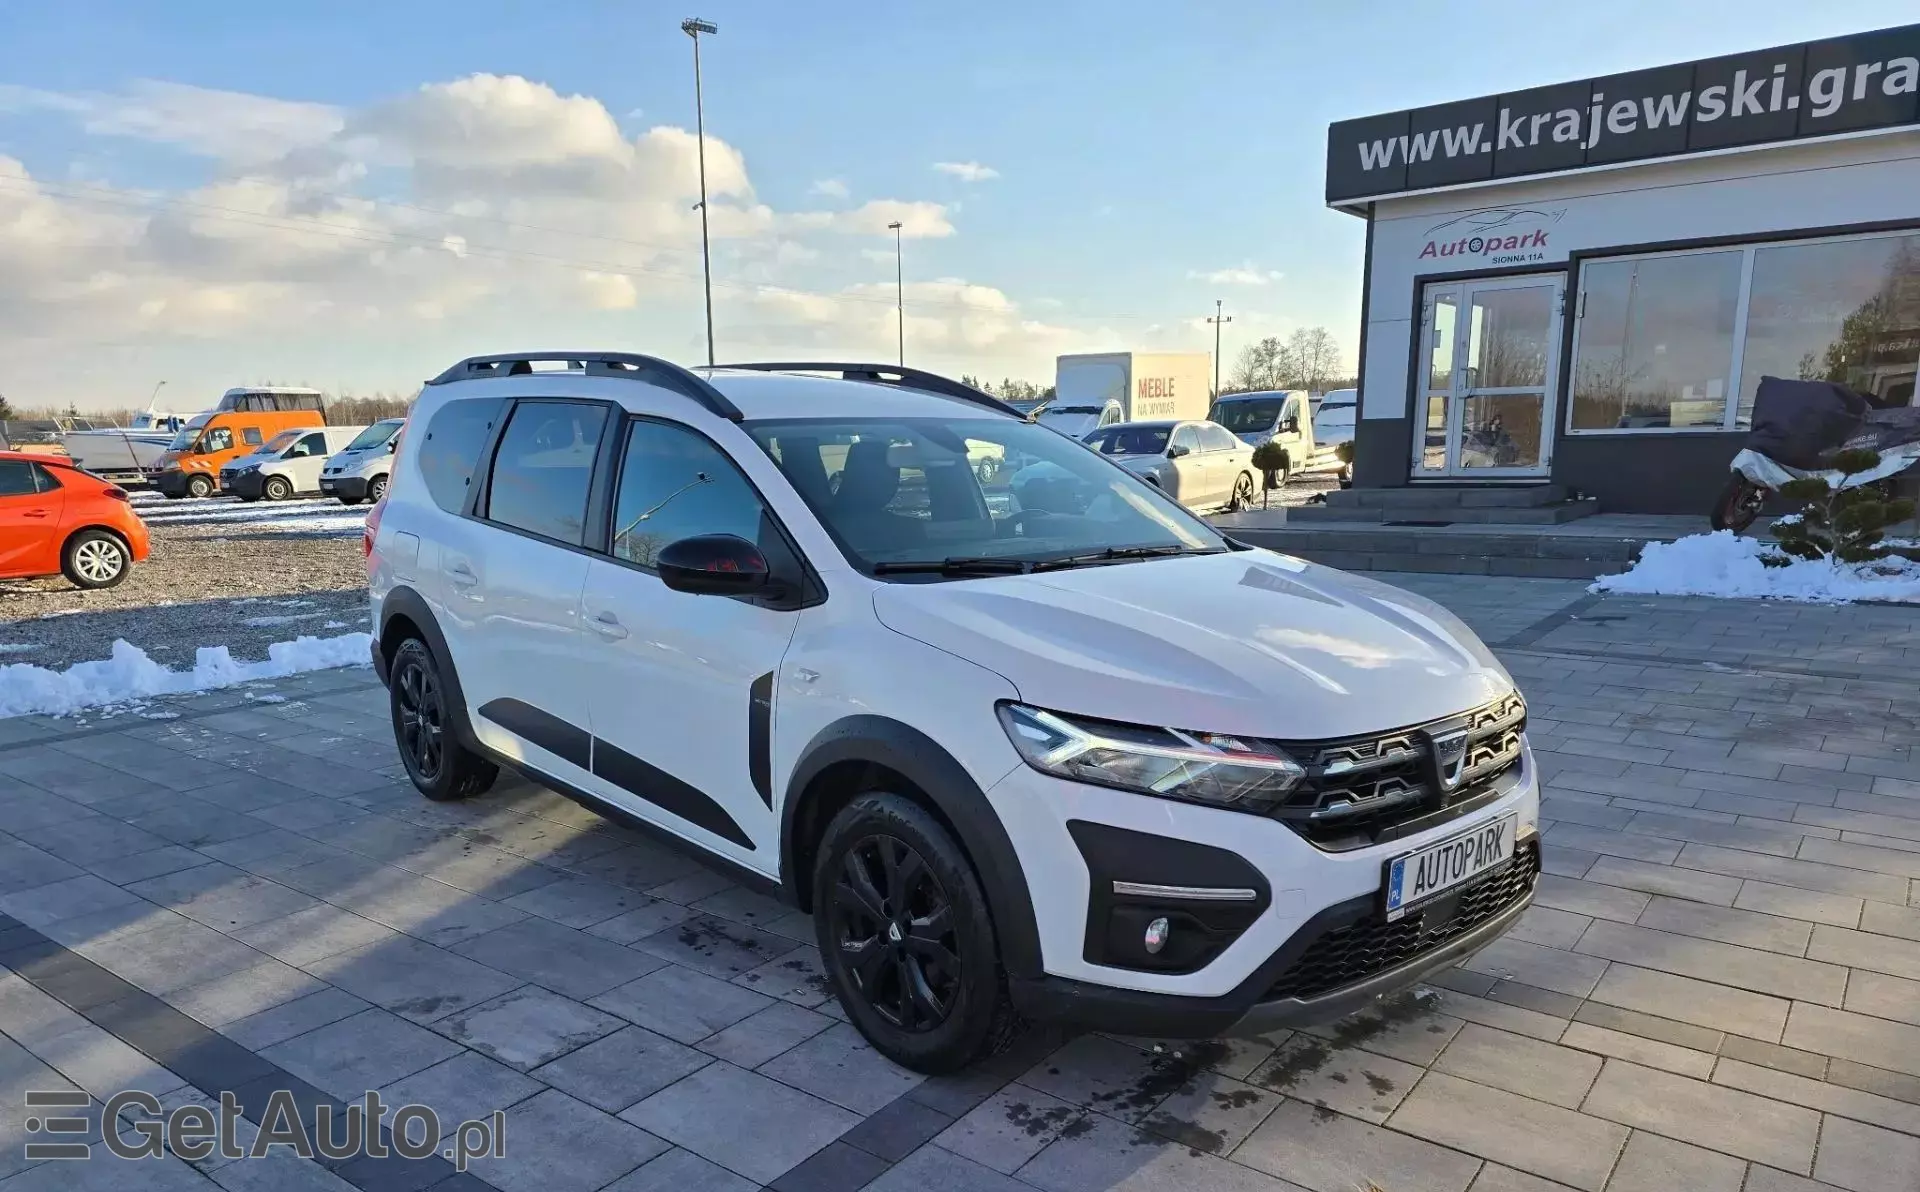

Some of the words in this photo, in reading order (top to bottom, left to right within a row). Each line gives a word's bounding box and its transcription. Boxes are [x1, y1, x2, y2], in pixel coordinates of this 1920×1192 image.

[1358, 57, 1920, 171] www.krajewski.gra
[1418, 229, 1549, 260] Autopark
[1492, 253, 1526, 265] SIONNA
[1527, 252, 1544, 262] 11A
[1138, 377, 1175, 399] MEBLE
[1137, 404, 1149, 417] NA
[1414, 824, 1506, 896] AUTOPARK
[1390, 888, 1401, 902] PL
